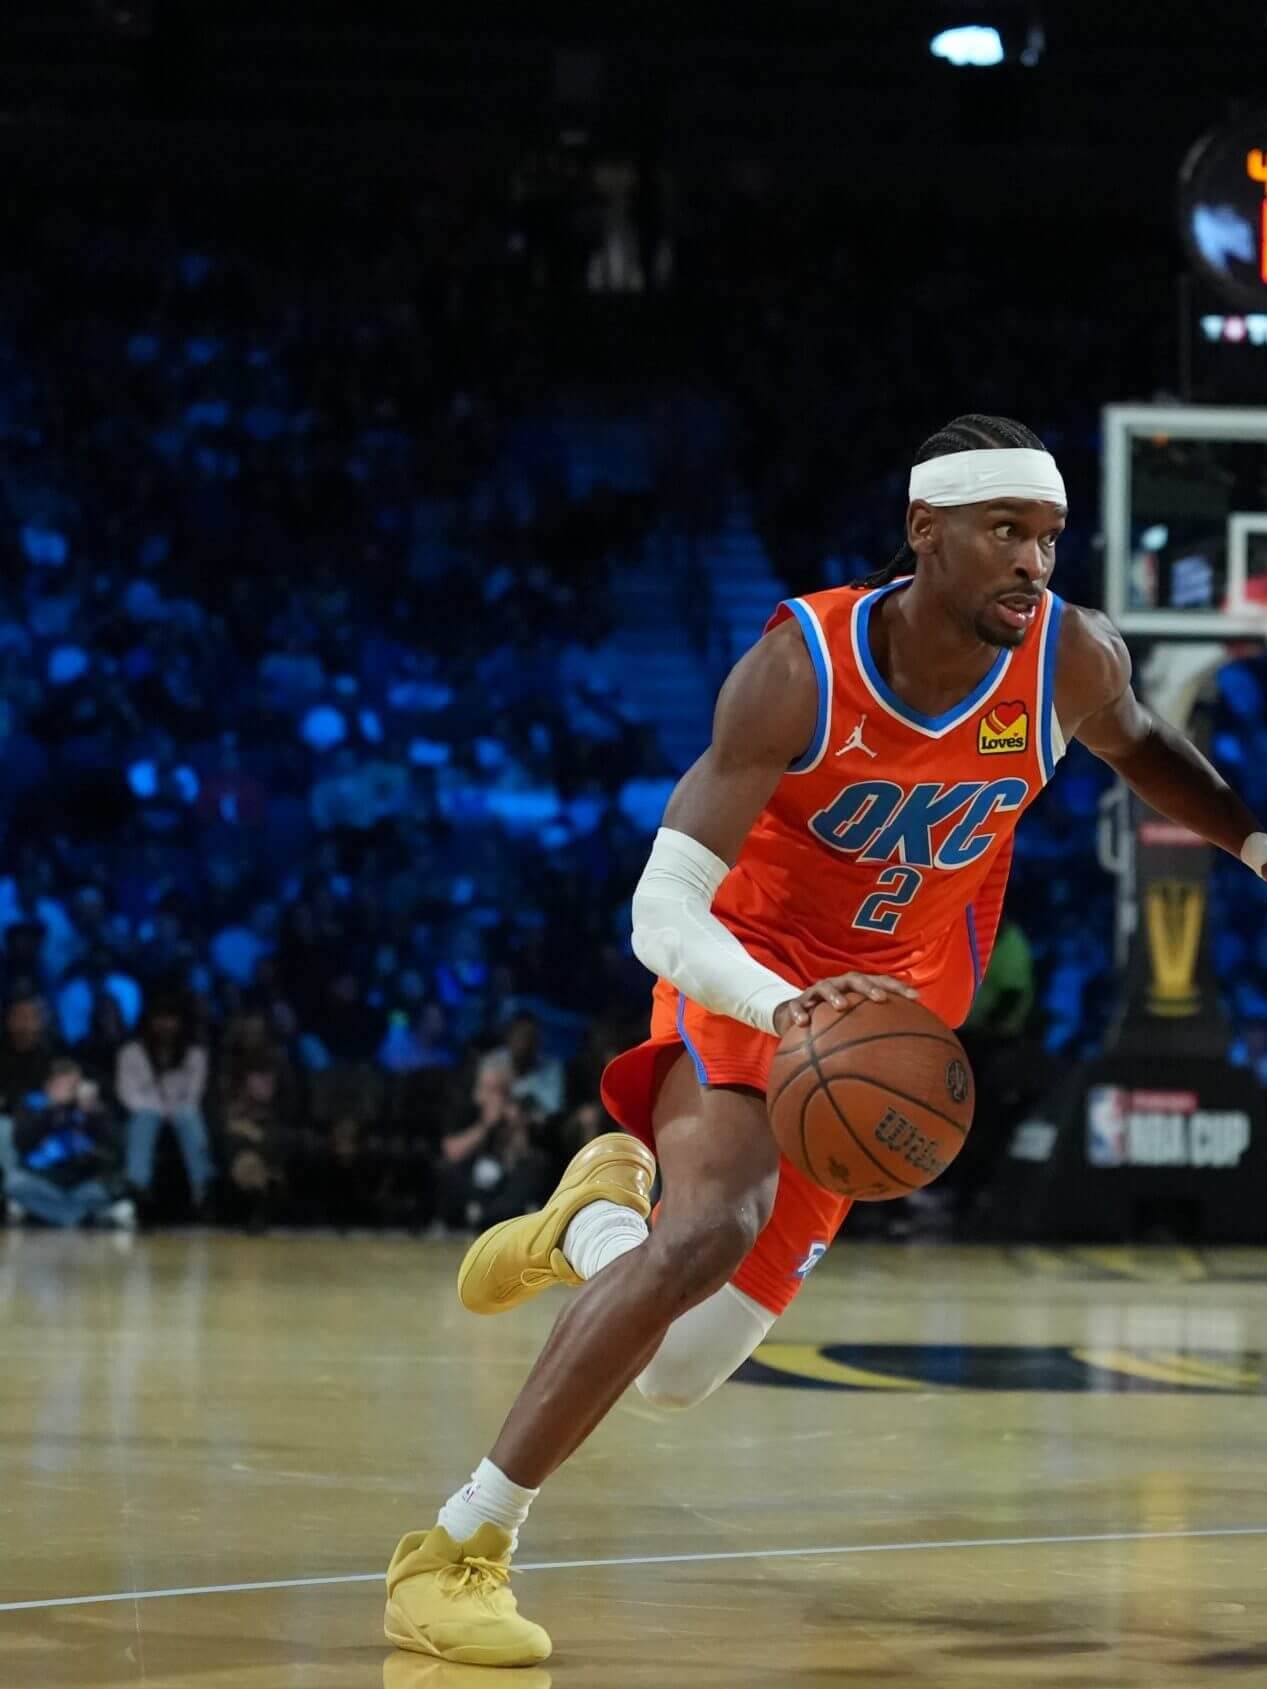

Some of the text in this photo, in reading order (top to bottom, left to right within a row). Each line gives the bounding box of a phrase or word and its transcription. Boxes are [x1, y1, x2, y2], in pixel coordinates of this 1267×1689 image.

[981, 732, 1024, 750] Love's
[807, 776, 1029, 870] OKC
[851, 864, 923, 934] 2
